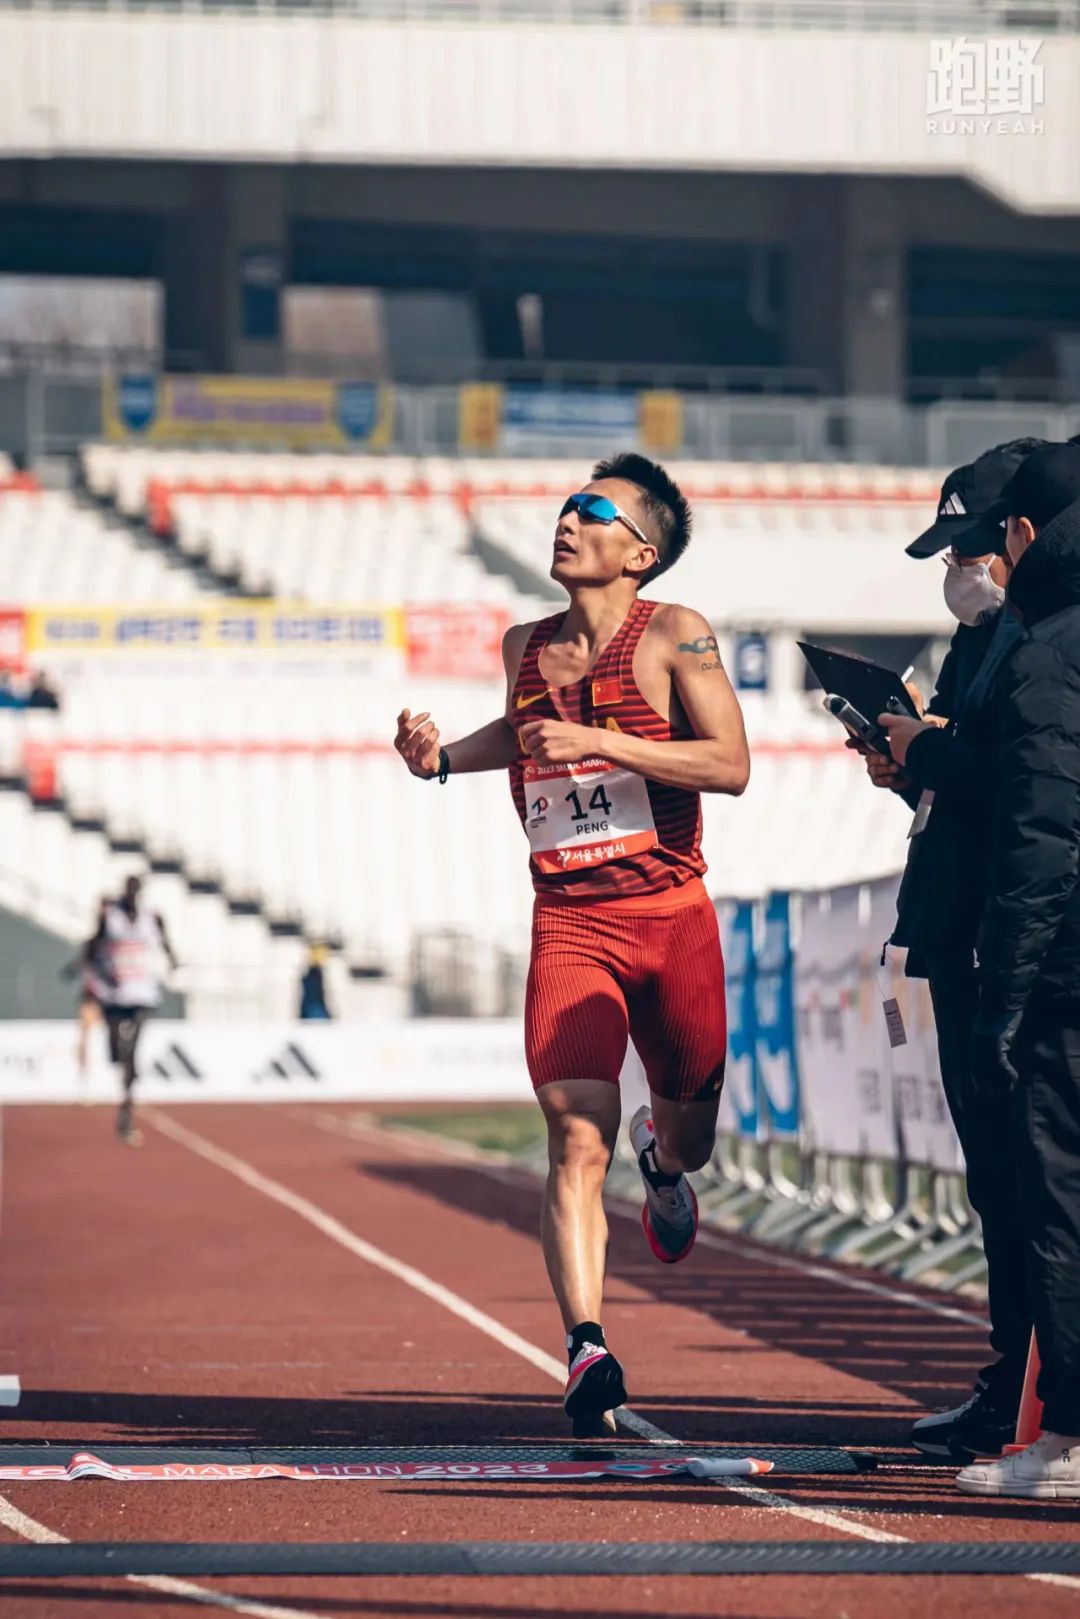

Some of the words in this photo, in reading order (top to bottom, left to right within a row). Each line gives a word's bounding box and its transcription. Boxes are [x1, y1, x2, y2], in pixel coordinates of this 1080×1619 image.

[564, 784, 612, 821] 14
[575, 820, 609, 836] PENG
[572, 842, 626, 863] 서울특별시
[415, 1464, 549, 1474] 2023
